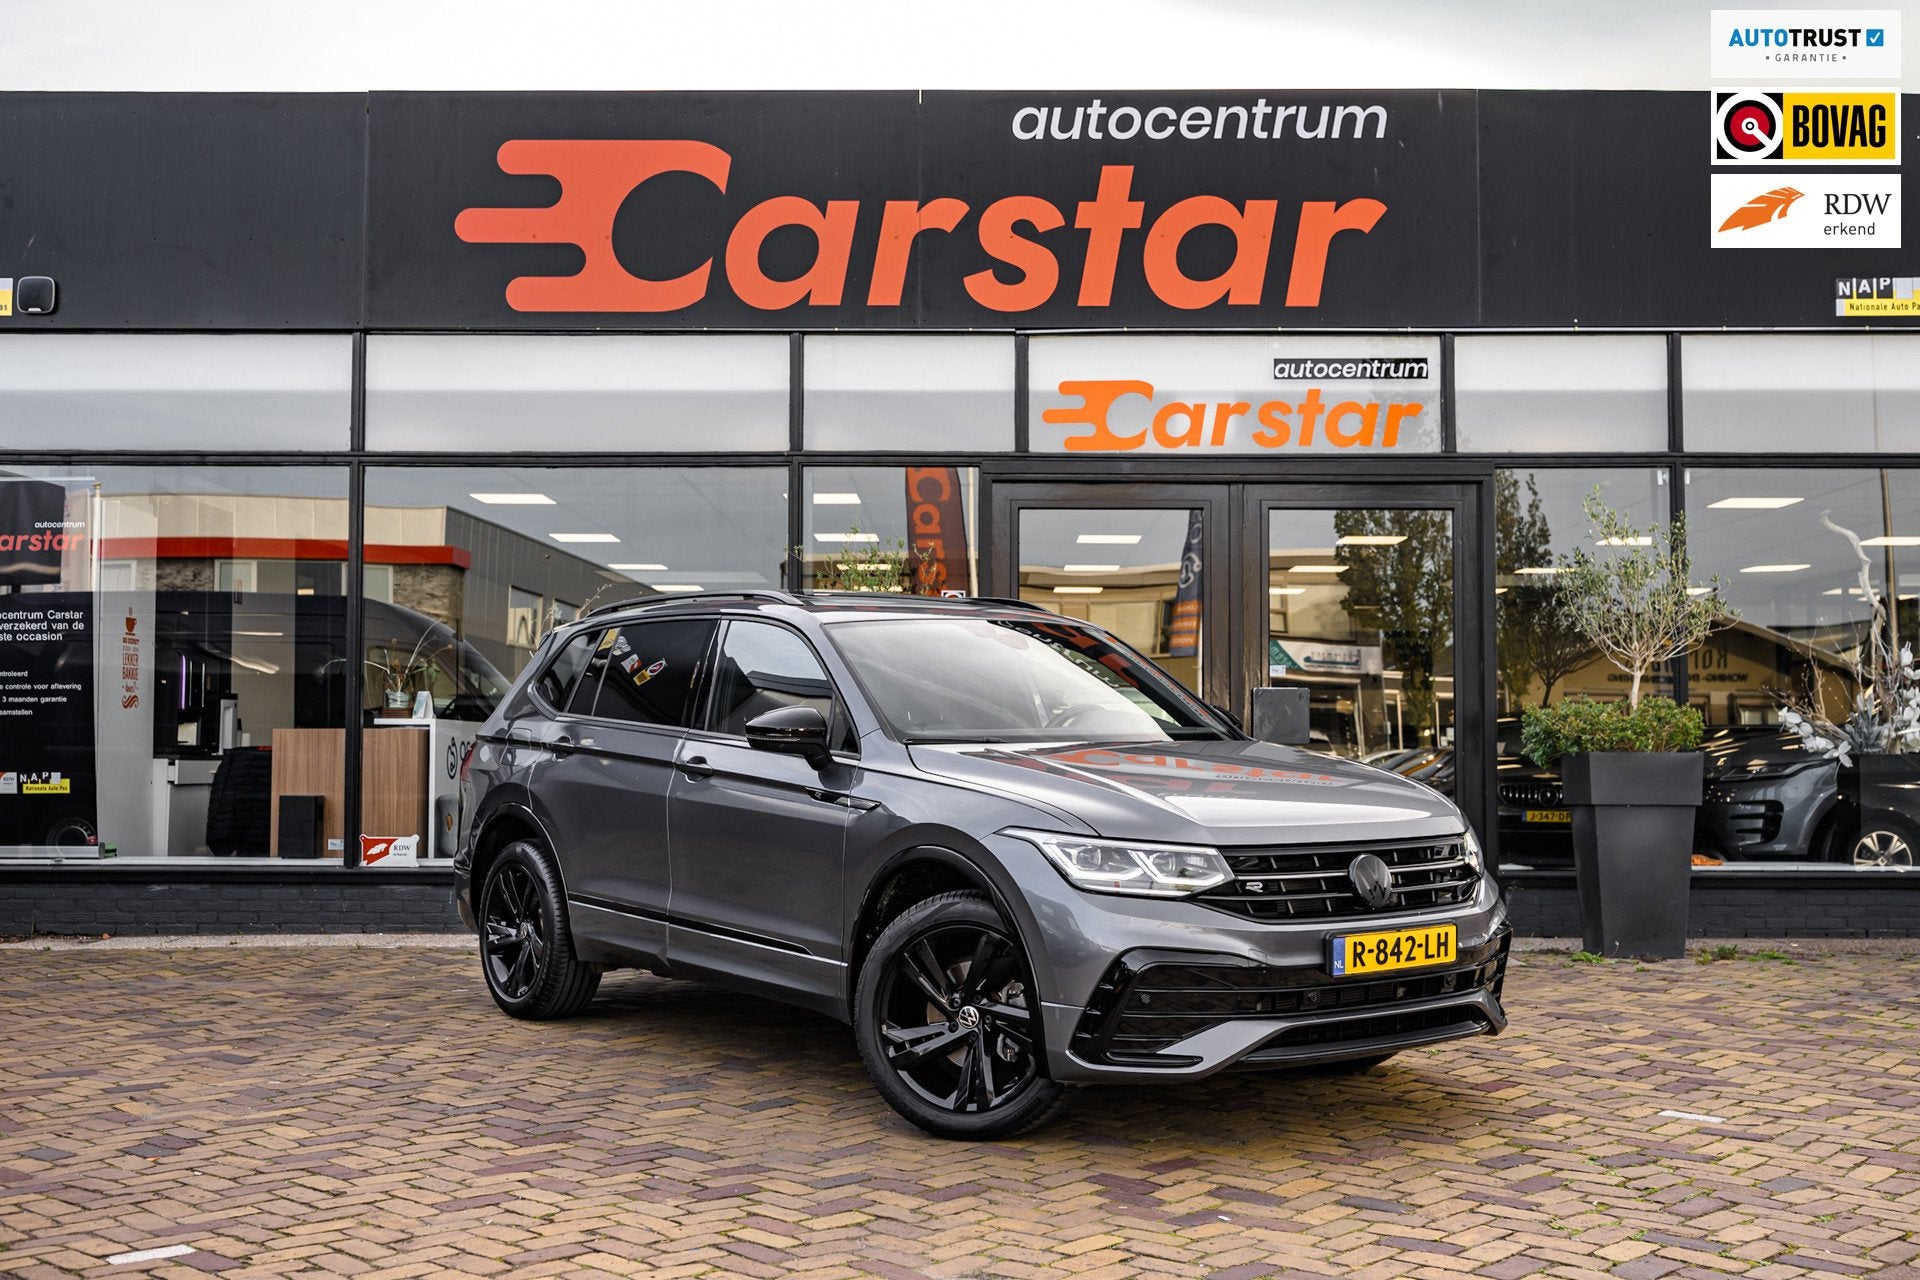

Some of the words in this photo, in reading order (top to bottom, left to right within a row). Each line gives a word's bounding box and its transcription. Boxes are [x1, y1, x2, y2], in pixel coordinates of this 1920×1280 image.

[1011, 98, 1388, 141] autocentrum
[454, 139, 1388, 312] Carstar
[1849, 302, 1888, 311] Nationale
[1891, 302, 1909, 311] Auto
[1274, 359, 1428, 378] autocentrum
[1042, 380, 1424, 451] Carstar
[47, 609, 84, 620] Carstar
[51, 622, 69, 630] van
[72, 620, 85, 630] de
[16, 632, 63, 641] occasion
[50, 683, 82, 691] aflevering
[40, 696, 67, 704] garantie
[1334, 960, 1344, 969] NL
[1352, 931, 1449, 968] R-842-LH
